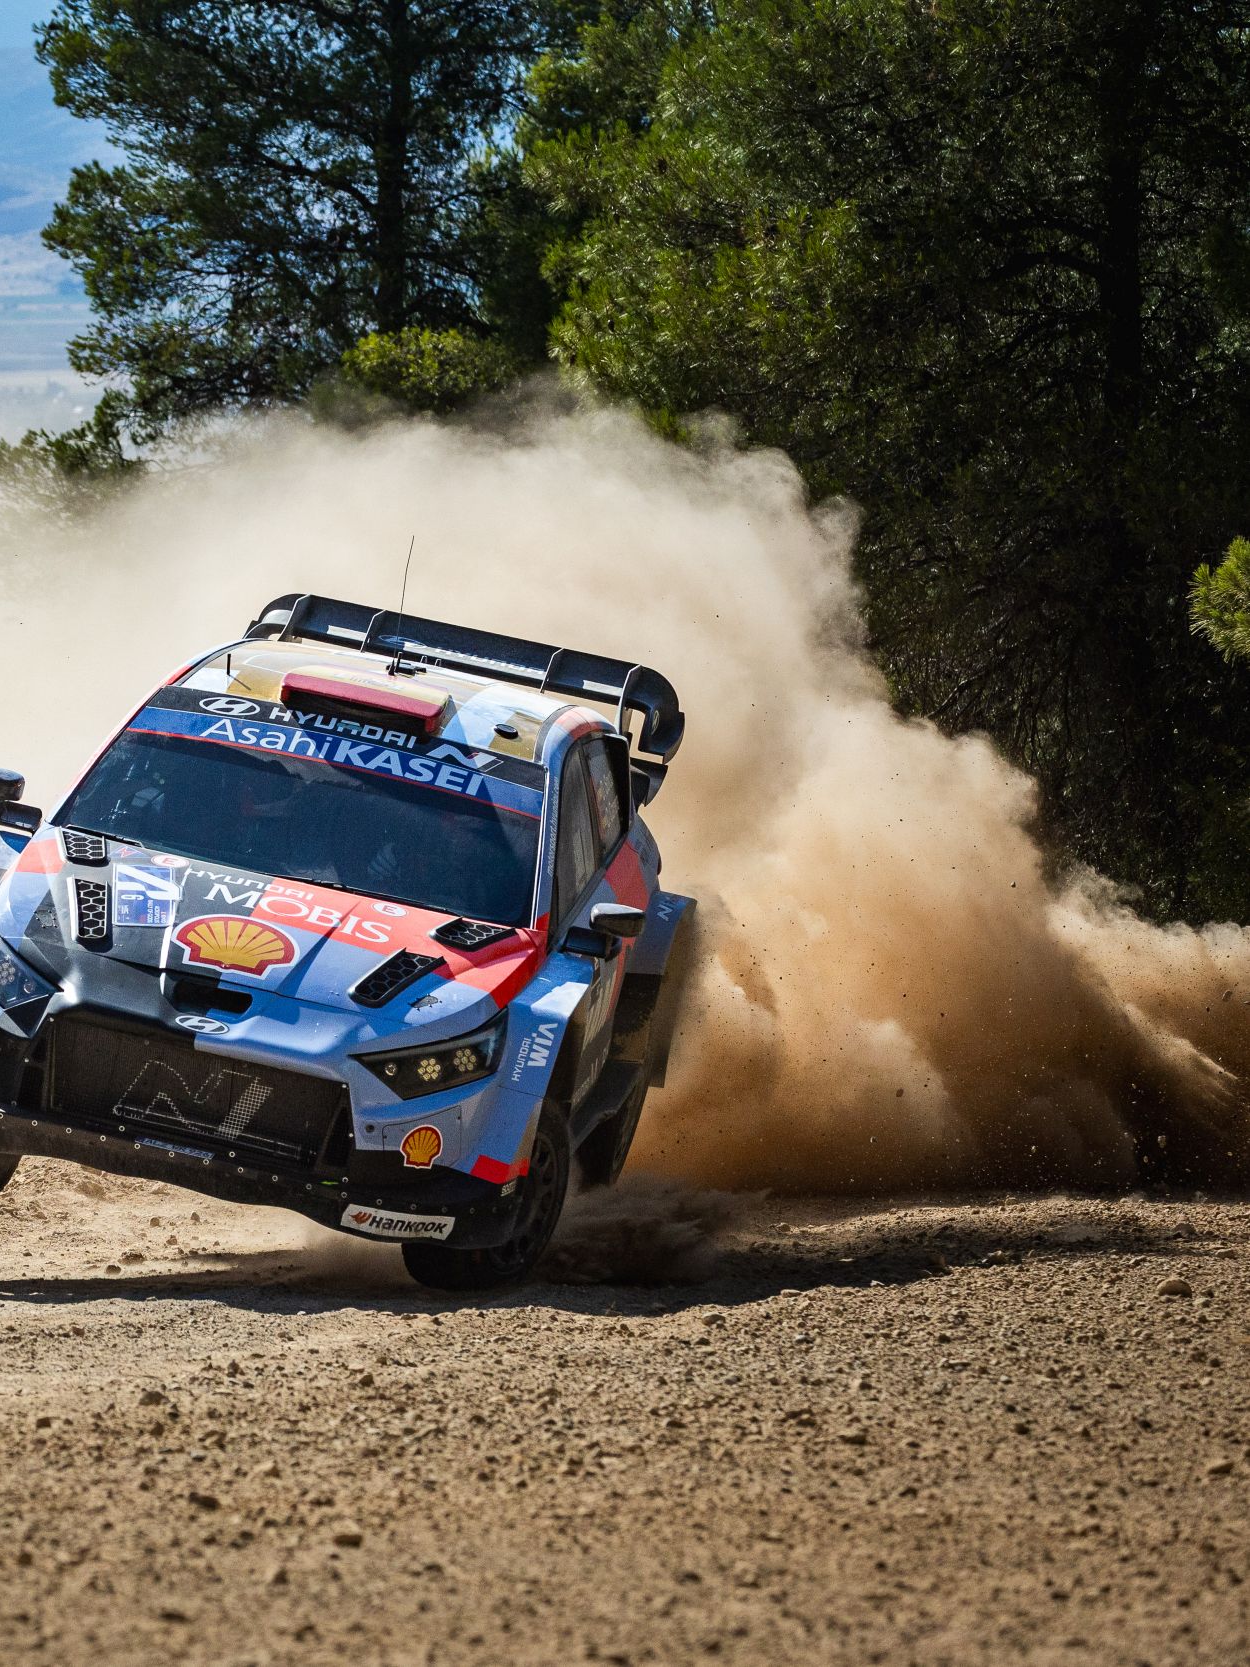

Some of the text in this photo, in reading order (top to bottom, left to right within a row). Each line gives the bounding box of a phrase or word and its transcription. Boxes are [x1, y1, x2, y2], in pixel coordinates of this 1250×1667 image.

[268, 705, 418, 750] HYUNDAI
[184, 867, 314, 901] HYUNDAI
[203, 882, 391, 943] MOBIS
[511, 1037, 532, 1082] HYUNDAI
